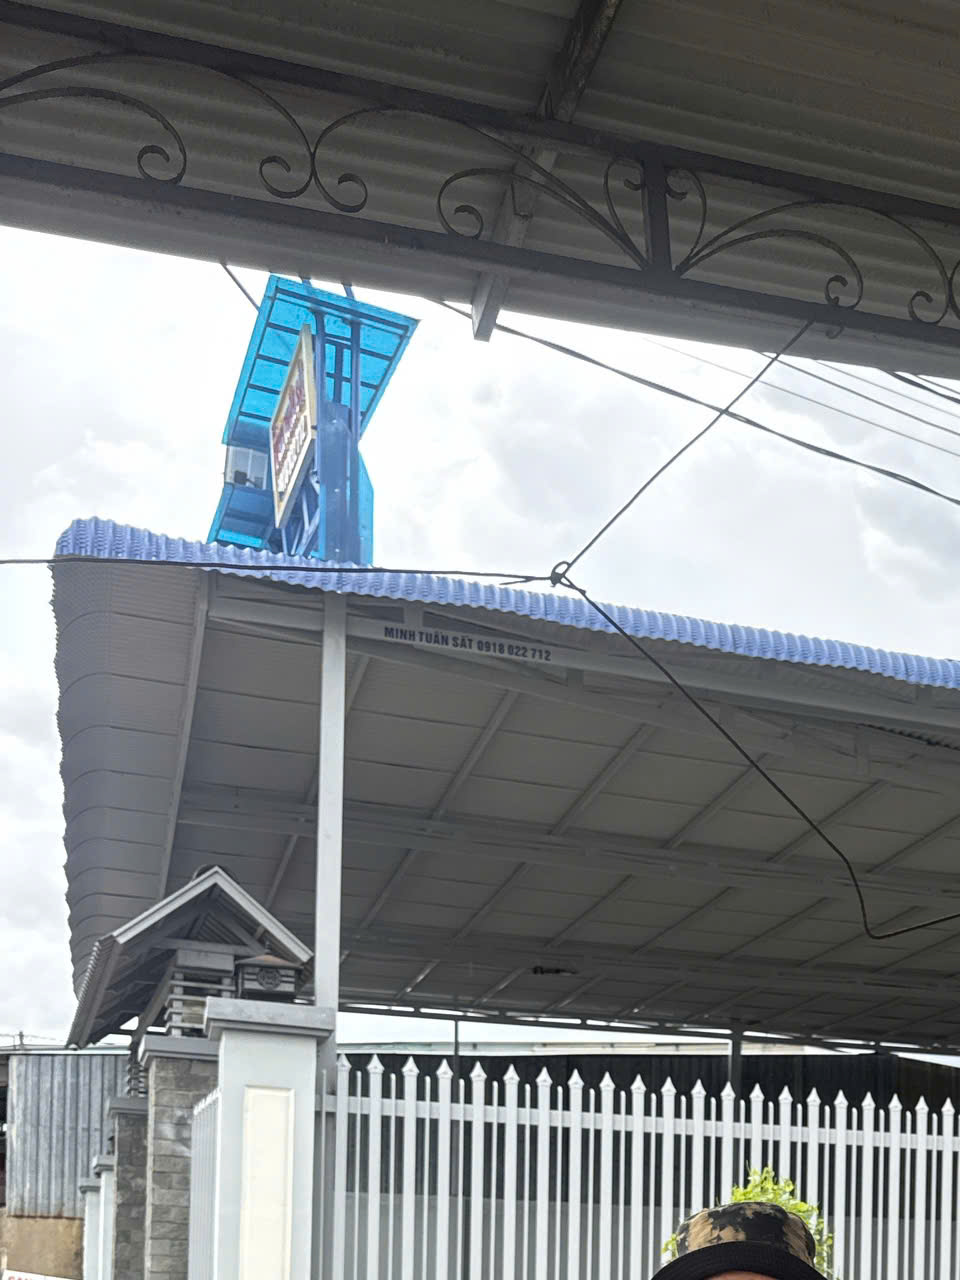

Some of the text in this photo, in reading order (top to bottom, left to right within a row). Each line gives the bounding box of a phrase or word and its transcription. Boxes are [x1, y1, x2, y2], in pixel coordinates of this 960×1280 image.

[384, 626, 416, 641] MINH
[477, 639, 505, 654] 0918
[507, 644, 528, 658] 022
[531, 648, 552, 661] 712
